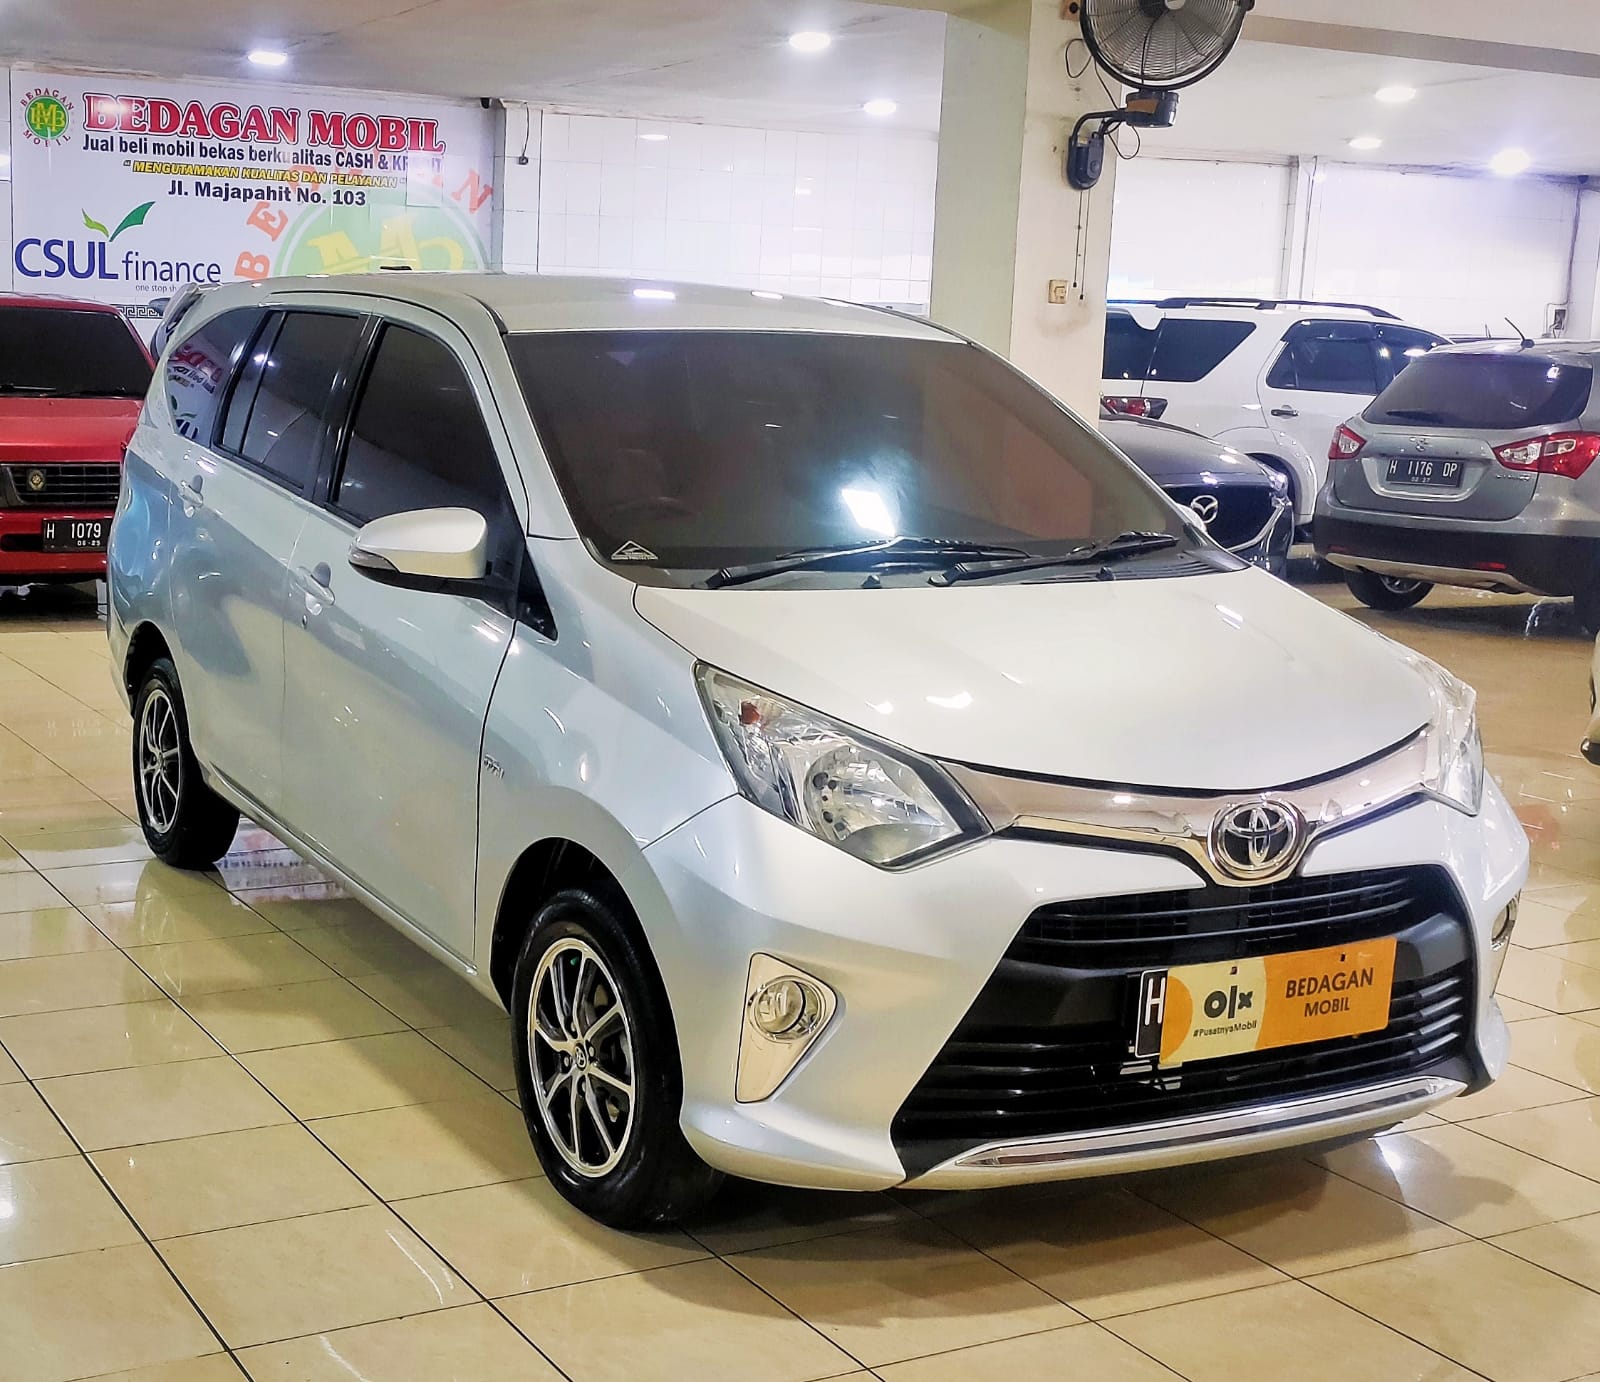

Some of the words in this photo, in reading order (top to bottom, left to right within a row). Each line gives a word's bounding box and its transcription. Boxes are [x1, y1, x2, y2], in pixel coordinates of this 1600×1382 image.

[20, 88, 74, 110] BEDAGAN
[84, 93, 299, 145] BEDAGAN
[308, 111, 446, 155] MOBIL
[83, 134, 114, 151] Jual
[119, 136, 148, 154] beli
[152, 140, 195, 158] mobil
[200, 142, 245, 160] bekas
[336, 152, 373, 169] CASH
[378, 155, 388, 170] &
[133, 160, 239, 178] MENGUTAMAKAN
[241, 168, 299, 182] KUALITAS
[301, 172, 327, 184] DAN
[331, 174, 397, 188] PELAYANAN
[195, 182, 291, 201] Majapahit
[297, 187, 326, 204] No.
[333, 190, 366, 206] 103
[14, 238, 119, 280] CSUL
[122, 250, 222, 283] finance
[151, 284, 168, 294] stop
[1389, 459, 1398, 474] H
[1408, 461, 1433, 476] 1176
[1442, 462, 1458, 477] DP
[46, 522, 55, 539] H
[71, 522, 101, 539] 1079
[1285, 967, 1374, 999] BEDAGAN
[1144, 977, 1166, 1026] H
[1203, 985, 1253, 1019] olx
[1304, 996, 1350, 1017] MOBIL
[1193, 1020, 1257, 1037] #PusatnyaMobil
